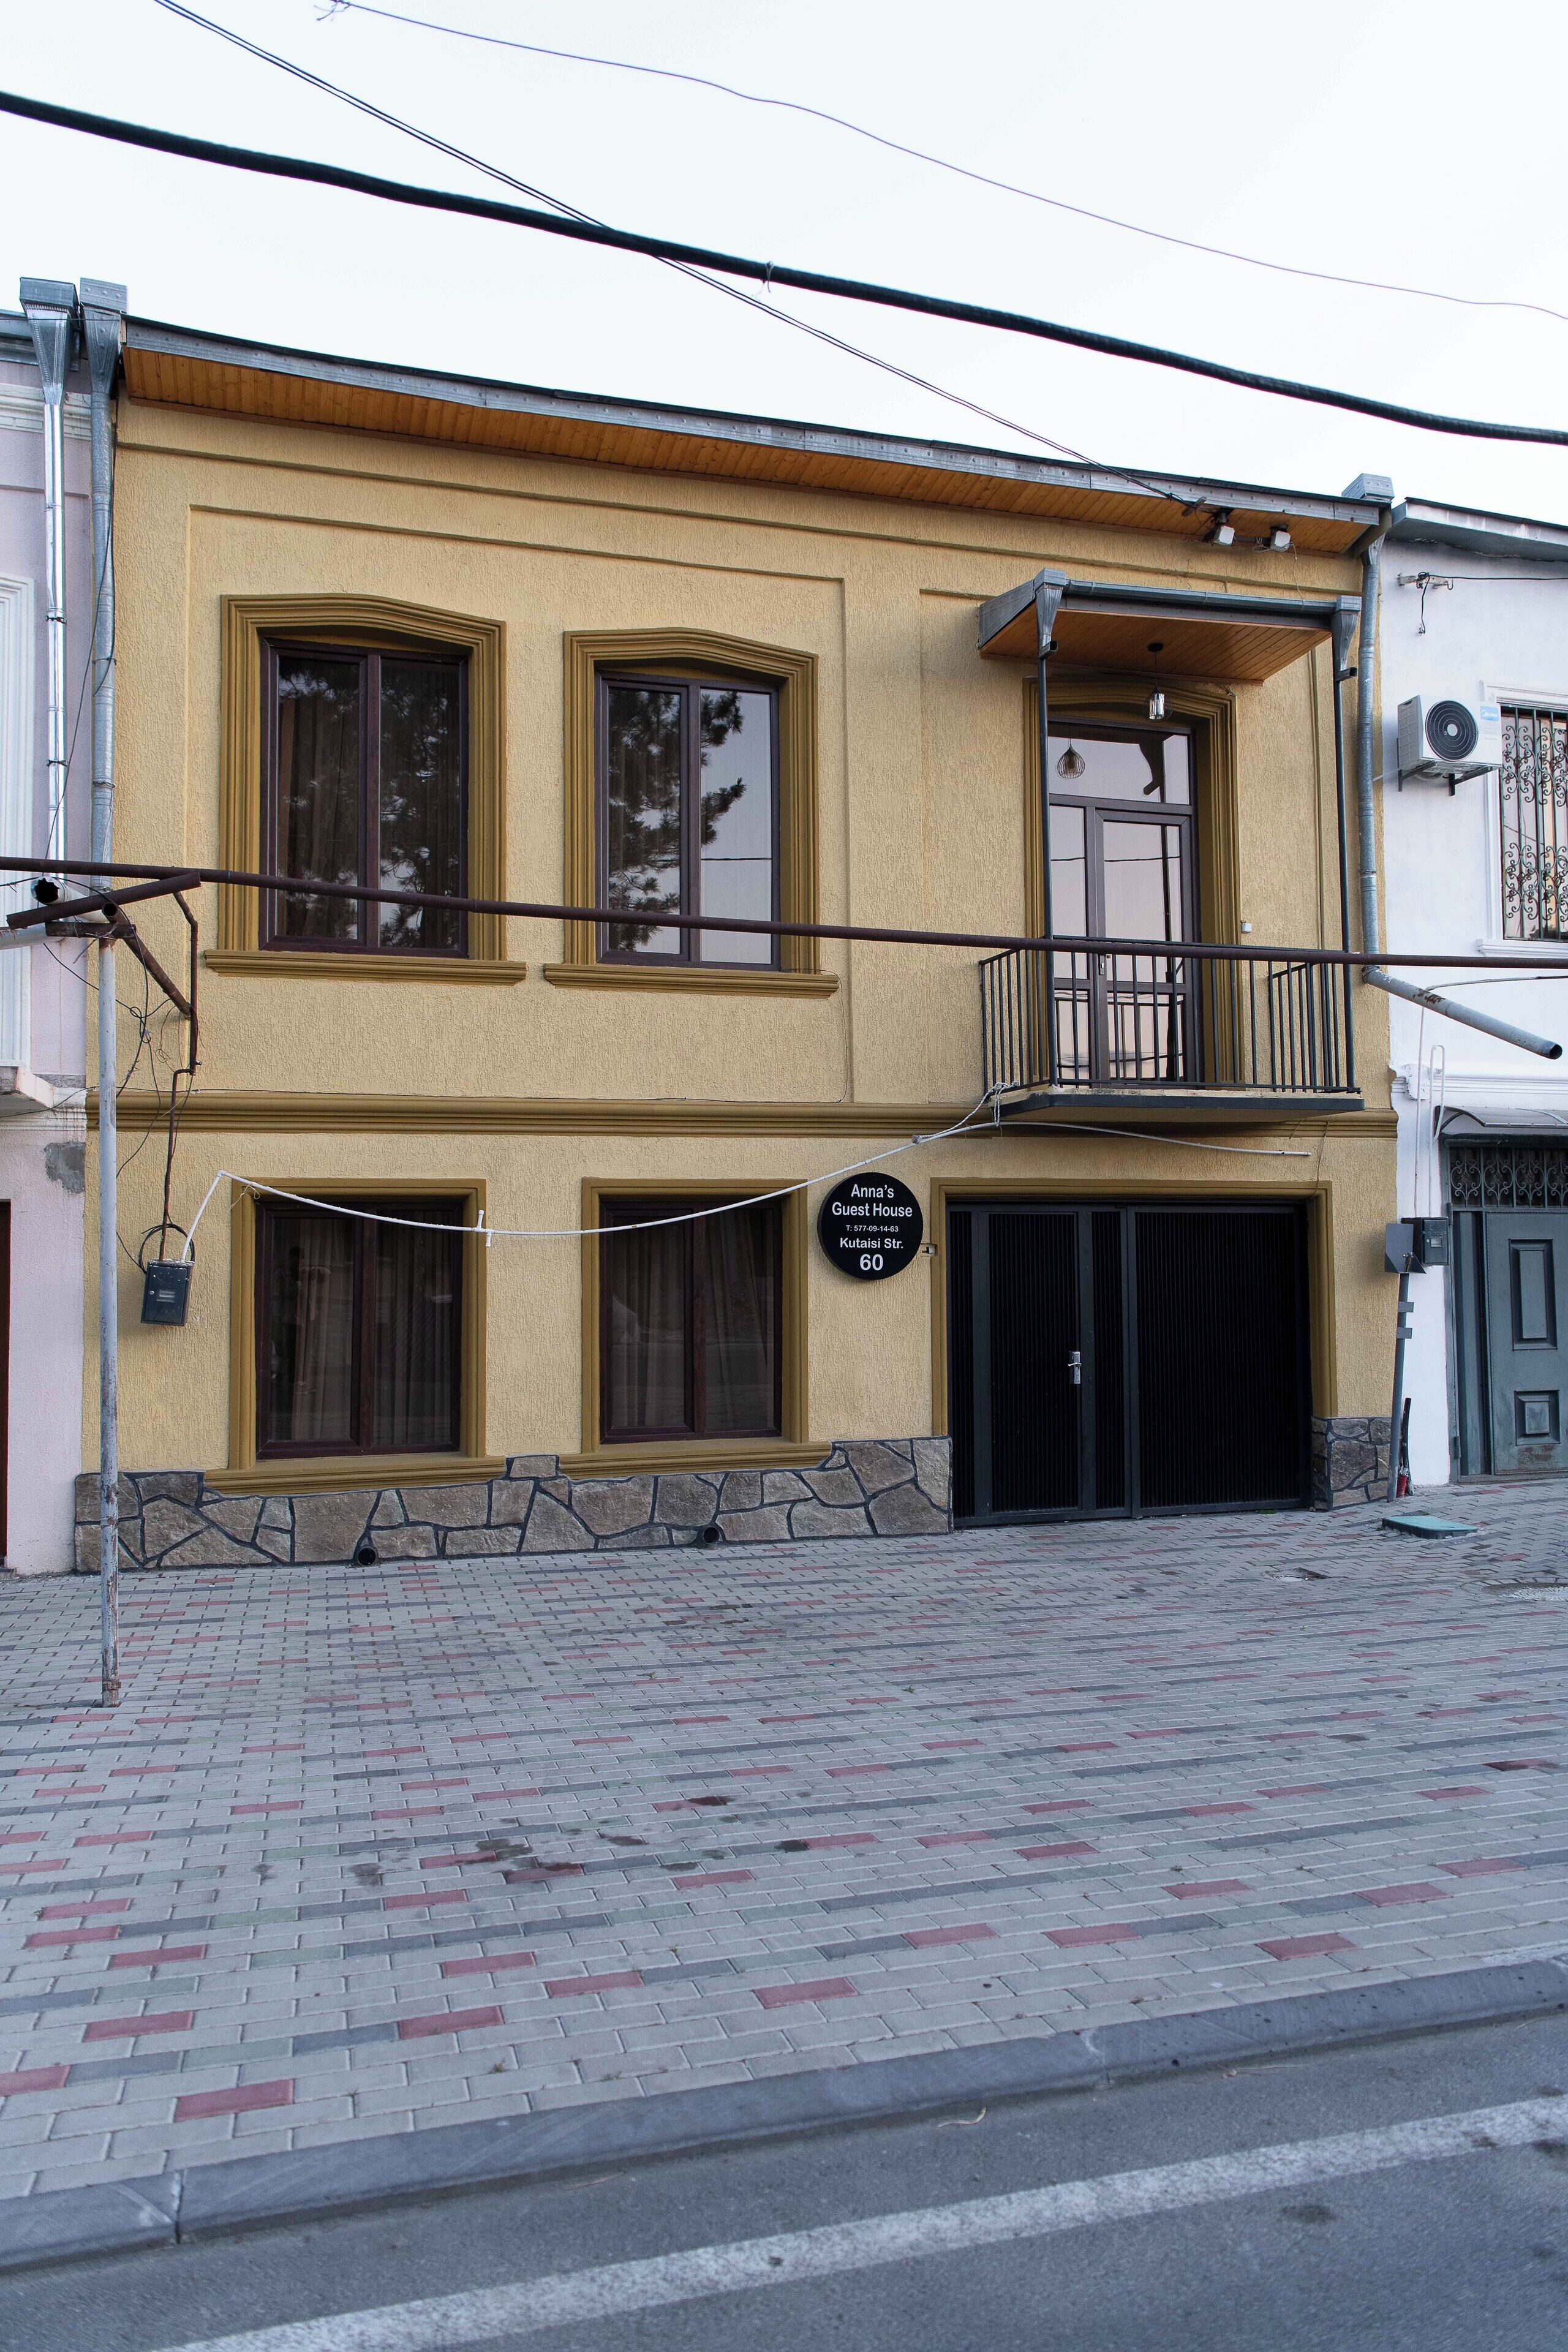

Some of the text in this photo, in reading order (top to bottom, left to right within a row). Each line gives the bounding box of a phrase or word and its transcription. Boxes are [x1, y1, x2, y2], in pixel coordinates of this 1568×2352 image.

[851, 1183, 894, 1199] Anna's
[832, 1201, 913, 1217] Guest House
[840, 1237, 903, 1249] Kutaisi Str.
[859, 1253, 884, 1271] 60
